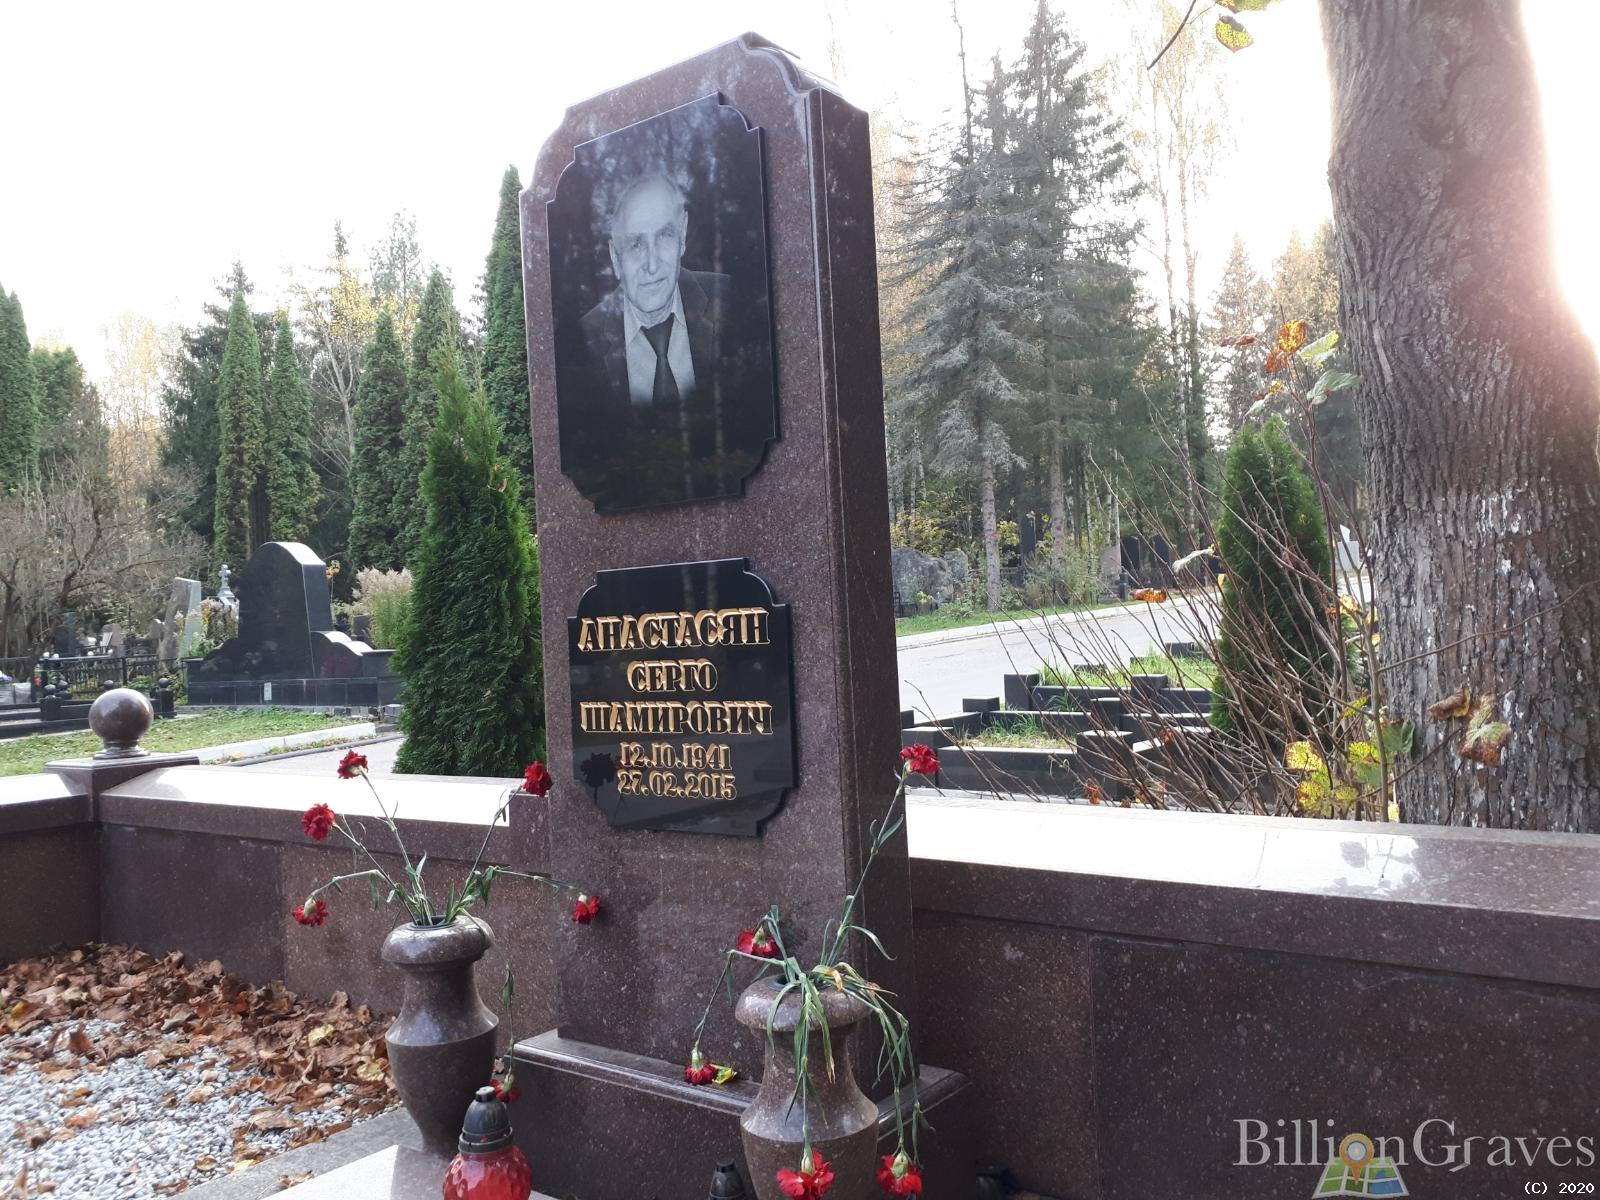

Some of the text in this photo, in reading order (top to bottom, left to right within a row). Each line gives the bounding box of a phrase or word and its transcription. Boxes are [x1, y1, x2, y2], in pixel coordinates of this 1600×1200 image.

[577, 606, 771, 651] АНАСТАСЯН
[627, 658, 718, 692] СЕРГО
[579, 700, 773, 735] ШАМИРОВИЧ
[619, 742, 732, 771] 12.10.1941
[617, 770, 738, 800] 27.02.2015
